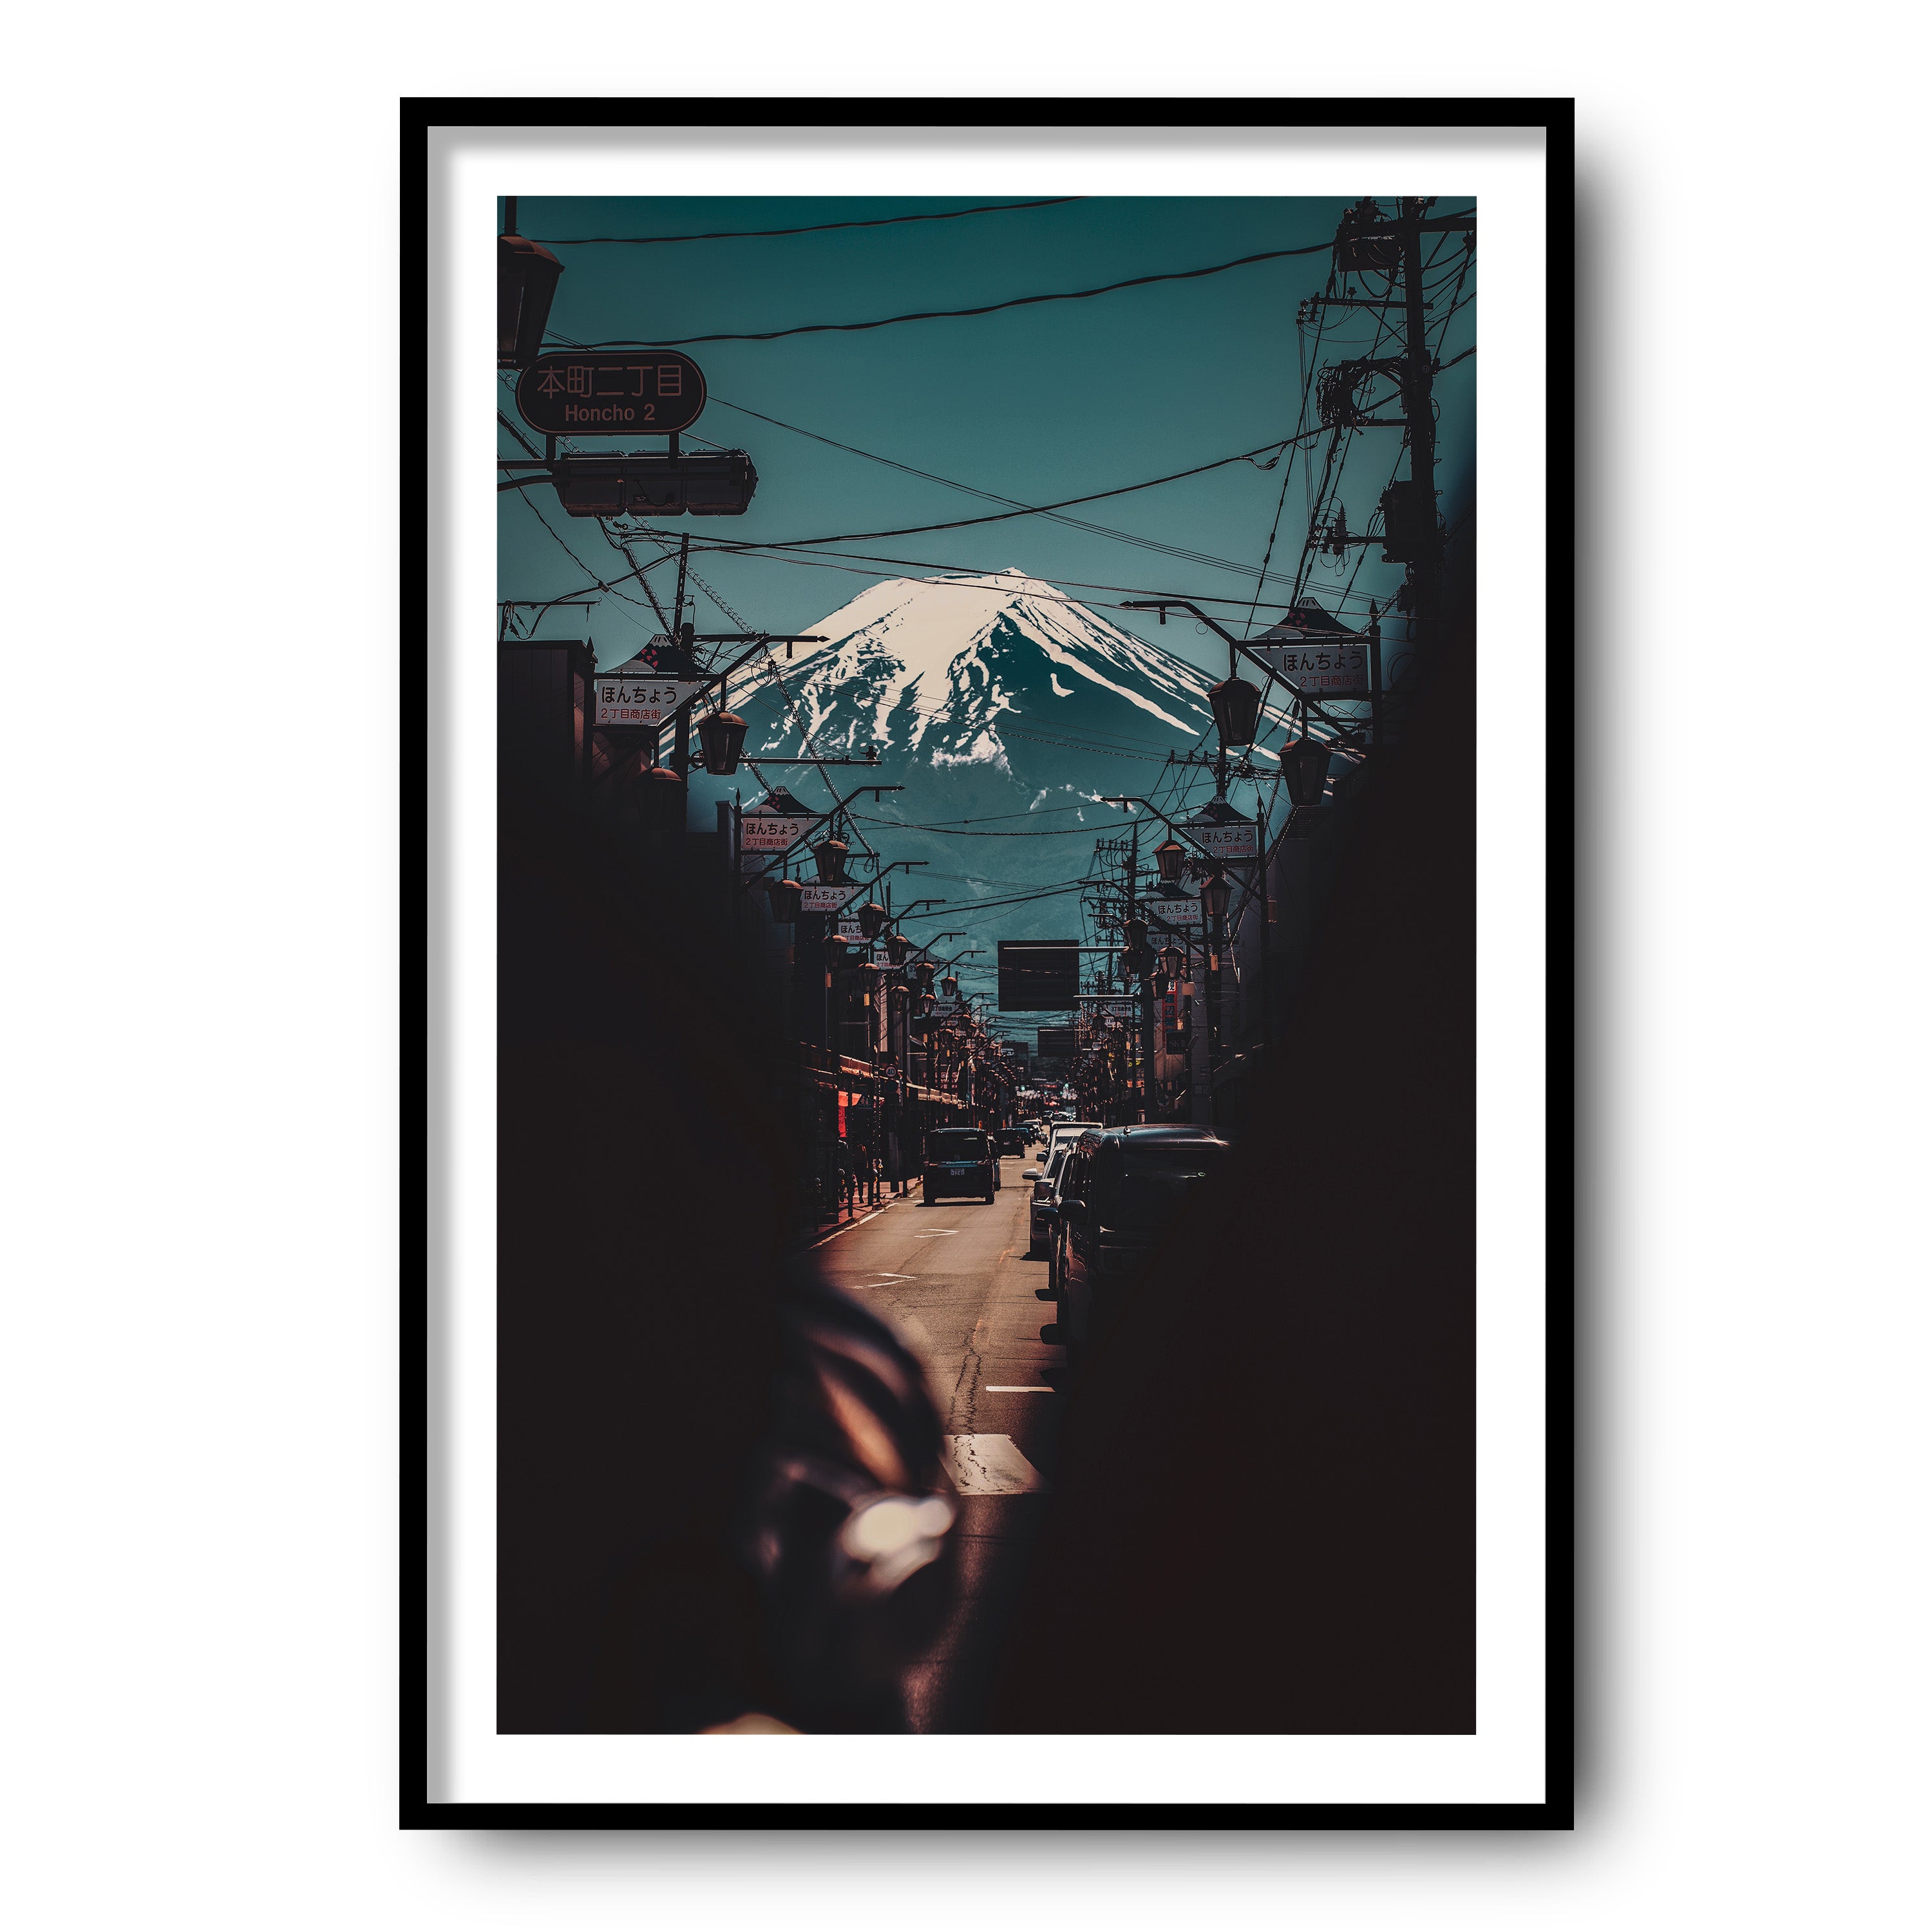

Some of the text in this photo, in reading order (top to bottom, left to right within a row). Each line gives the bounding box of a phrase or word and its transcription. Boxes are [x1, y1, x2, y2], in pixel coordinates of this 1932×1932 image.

[536, 365, 682, 399] 本町二丁目
[565, 402, 656, 421] Honcho 2
[1283, 650, 1363, 672] ほんちょう
[1300, 674, 1364, 687] 2丁目商店街
[601, 686, 677, 704] ほんちょう
[601, 708, 661, 719] 2丁目商店街
[746, 822, 799, 835] ほんちょう
[1202, 830, 1253, 844] ほんちょう
[1213, 844, 1254, 853] 2丁目商店街
[804, 890, 846, 900] ほんちょう
[1158, 903, 1198, 914] ほんちょう
[841, 925, 862, 933] ほんち
